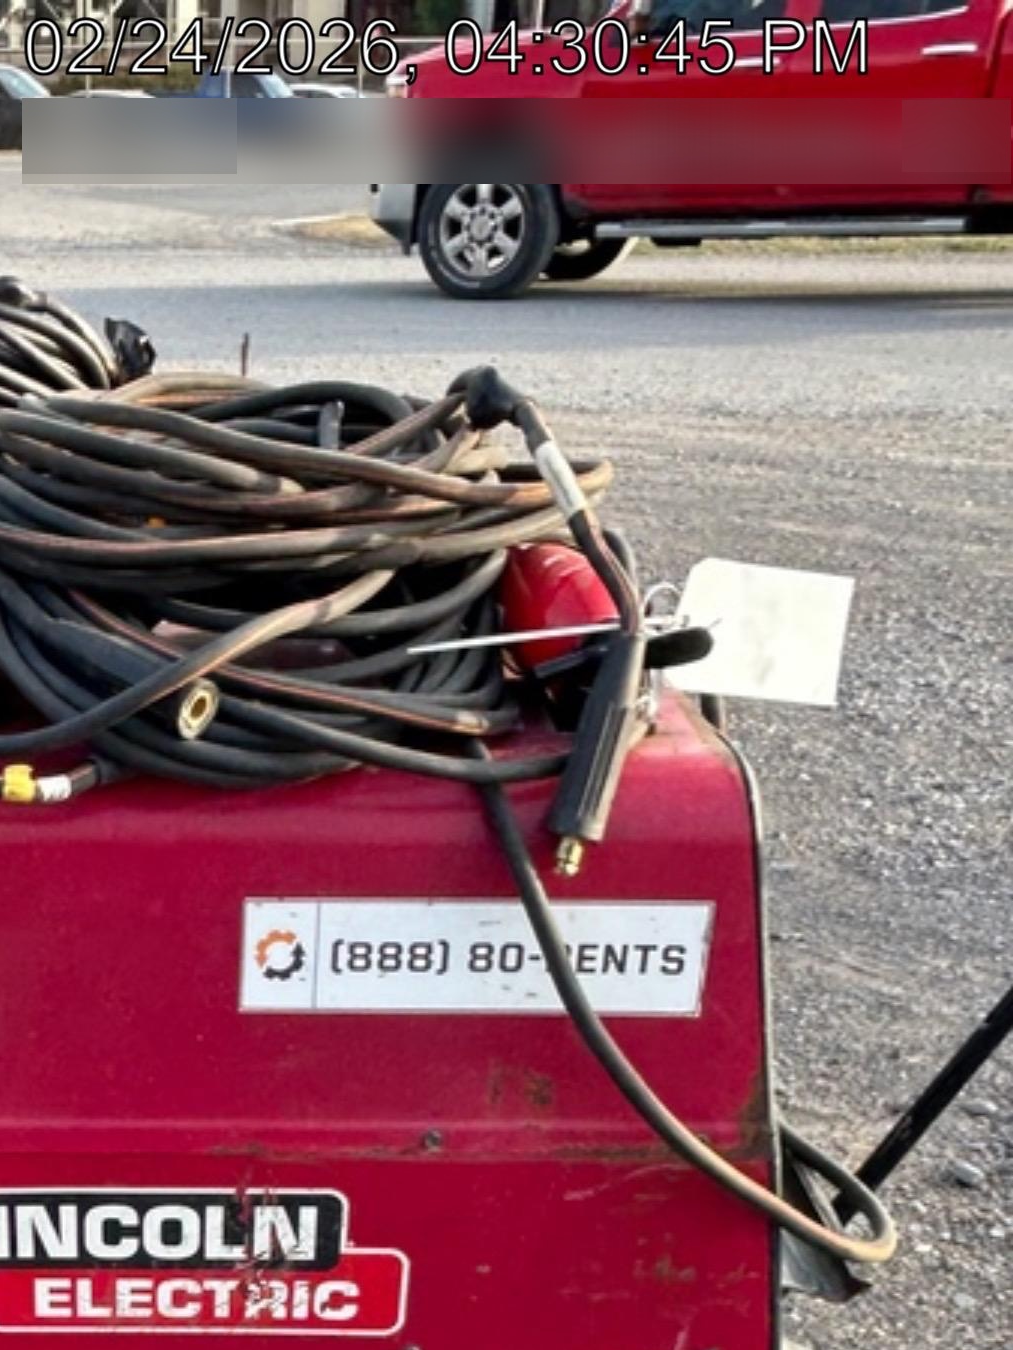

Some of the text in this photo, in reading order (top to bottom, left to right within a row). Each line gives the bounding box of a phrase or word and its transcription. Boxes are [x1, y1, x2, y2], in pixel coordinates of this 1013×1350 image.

[331, 940, 687, 976] (888) 80-ENTS
[34, 1277, 359, 1320] ELECTRIC
